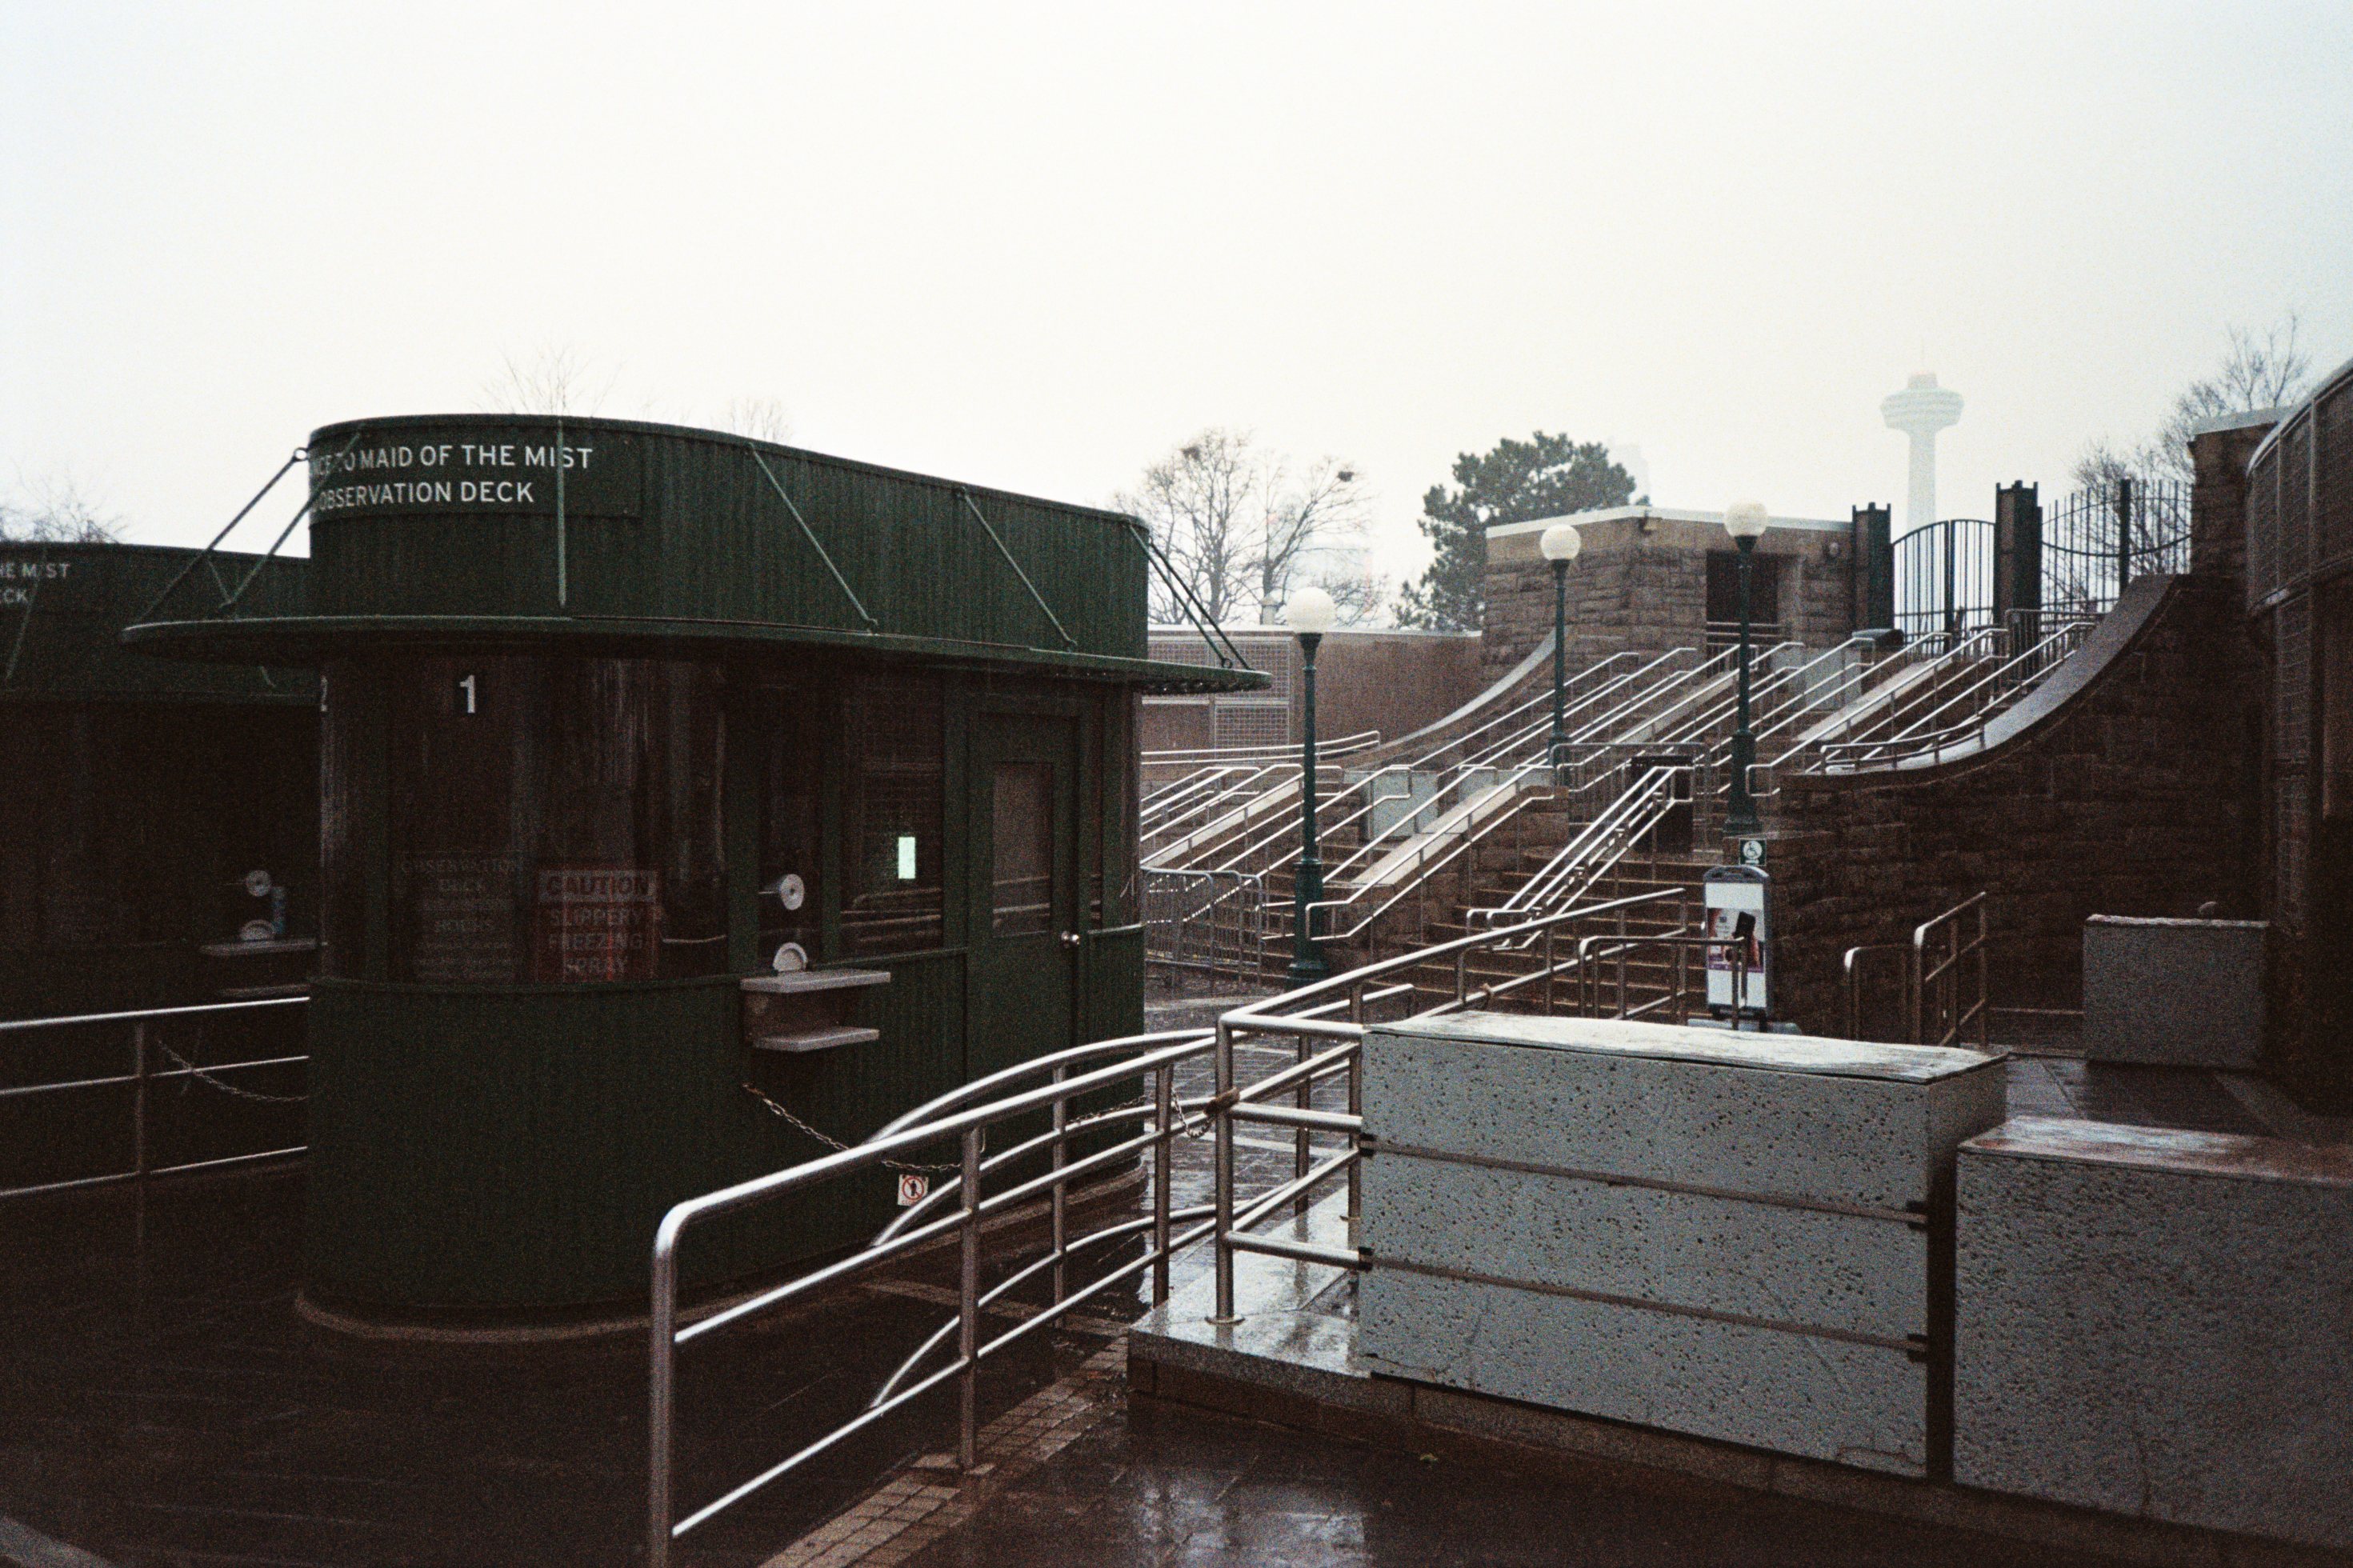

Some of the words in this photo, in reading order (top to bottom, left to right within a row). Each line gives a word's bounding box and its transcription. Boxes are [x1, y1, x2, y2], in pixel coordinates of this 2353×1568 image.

[359, 446, 414, 470] MAID
[420, 446, 453, 467] OF
[462, 445, 515, 466] THE
[525, 446, 593, 469] MIST
[319, 482, 451, 511] OBSERVATION
[461, 481, 534, 503] DECK
[22, 562, 70, 578] MST
[459, 674, 477, 714] 1
[547, 875, 650, 895] CAUTION
[550, 908, 643, 926] SLIPPERY
[549, 933, 642, 951] FREEZING
